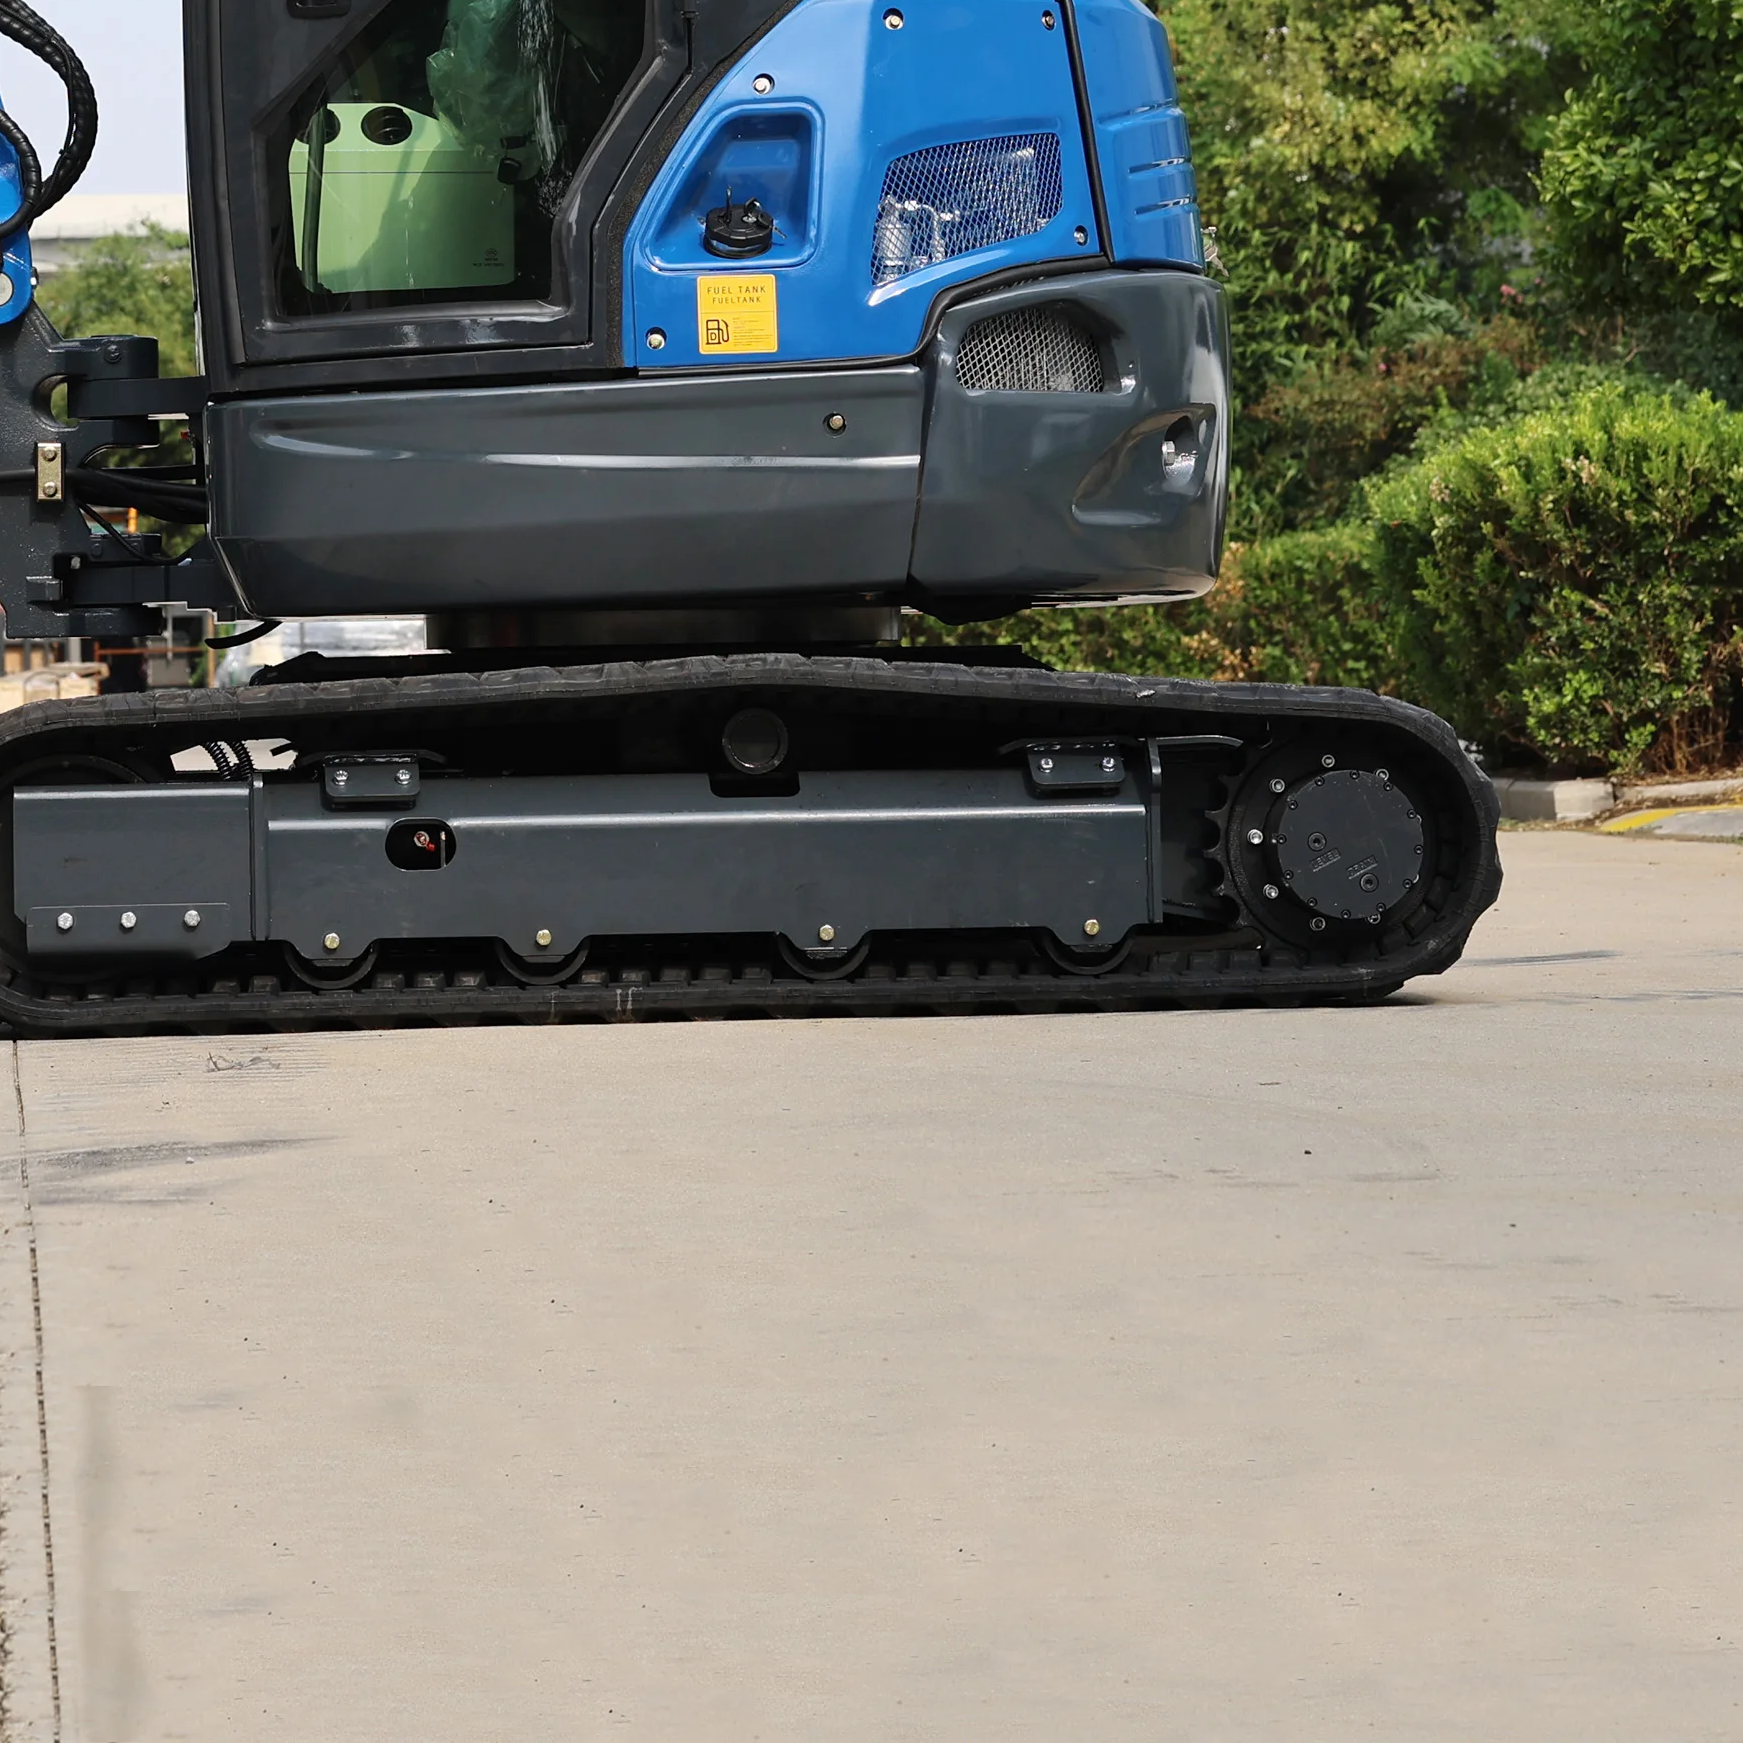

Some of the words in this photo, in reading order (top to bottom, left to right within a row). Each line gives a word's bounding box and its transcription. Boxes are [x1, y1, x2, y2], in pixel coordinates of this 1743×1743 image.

[707, 286, 733, 295] FUEL
[738, 285, 766, 294] TANK
[712, 296, 761, 305] FUELTANK
